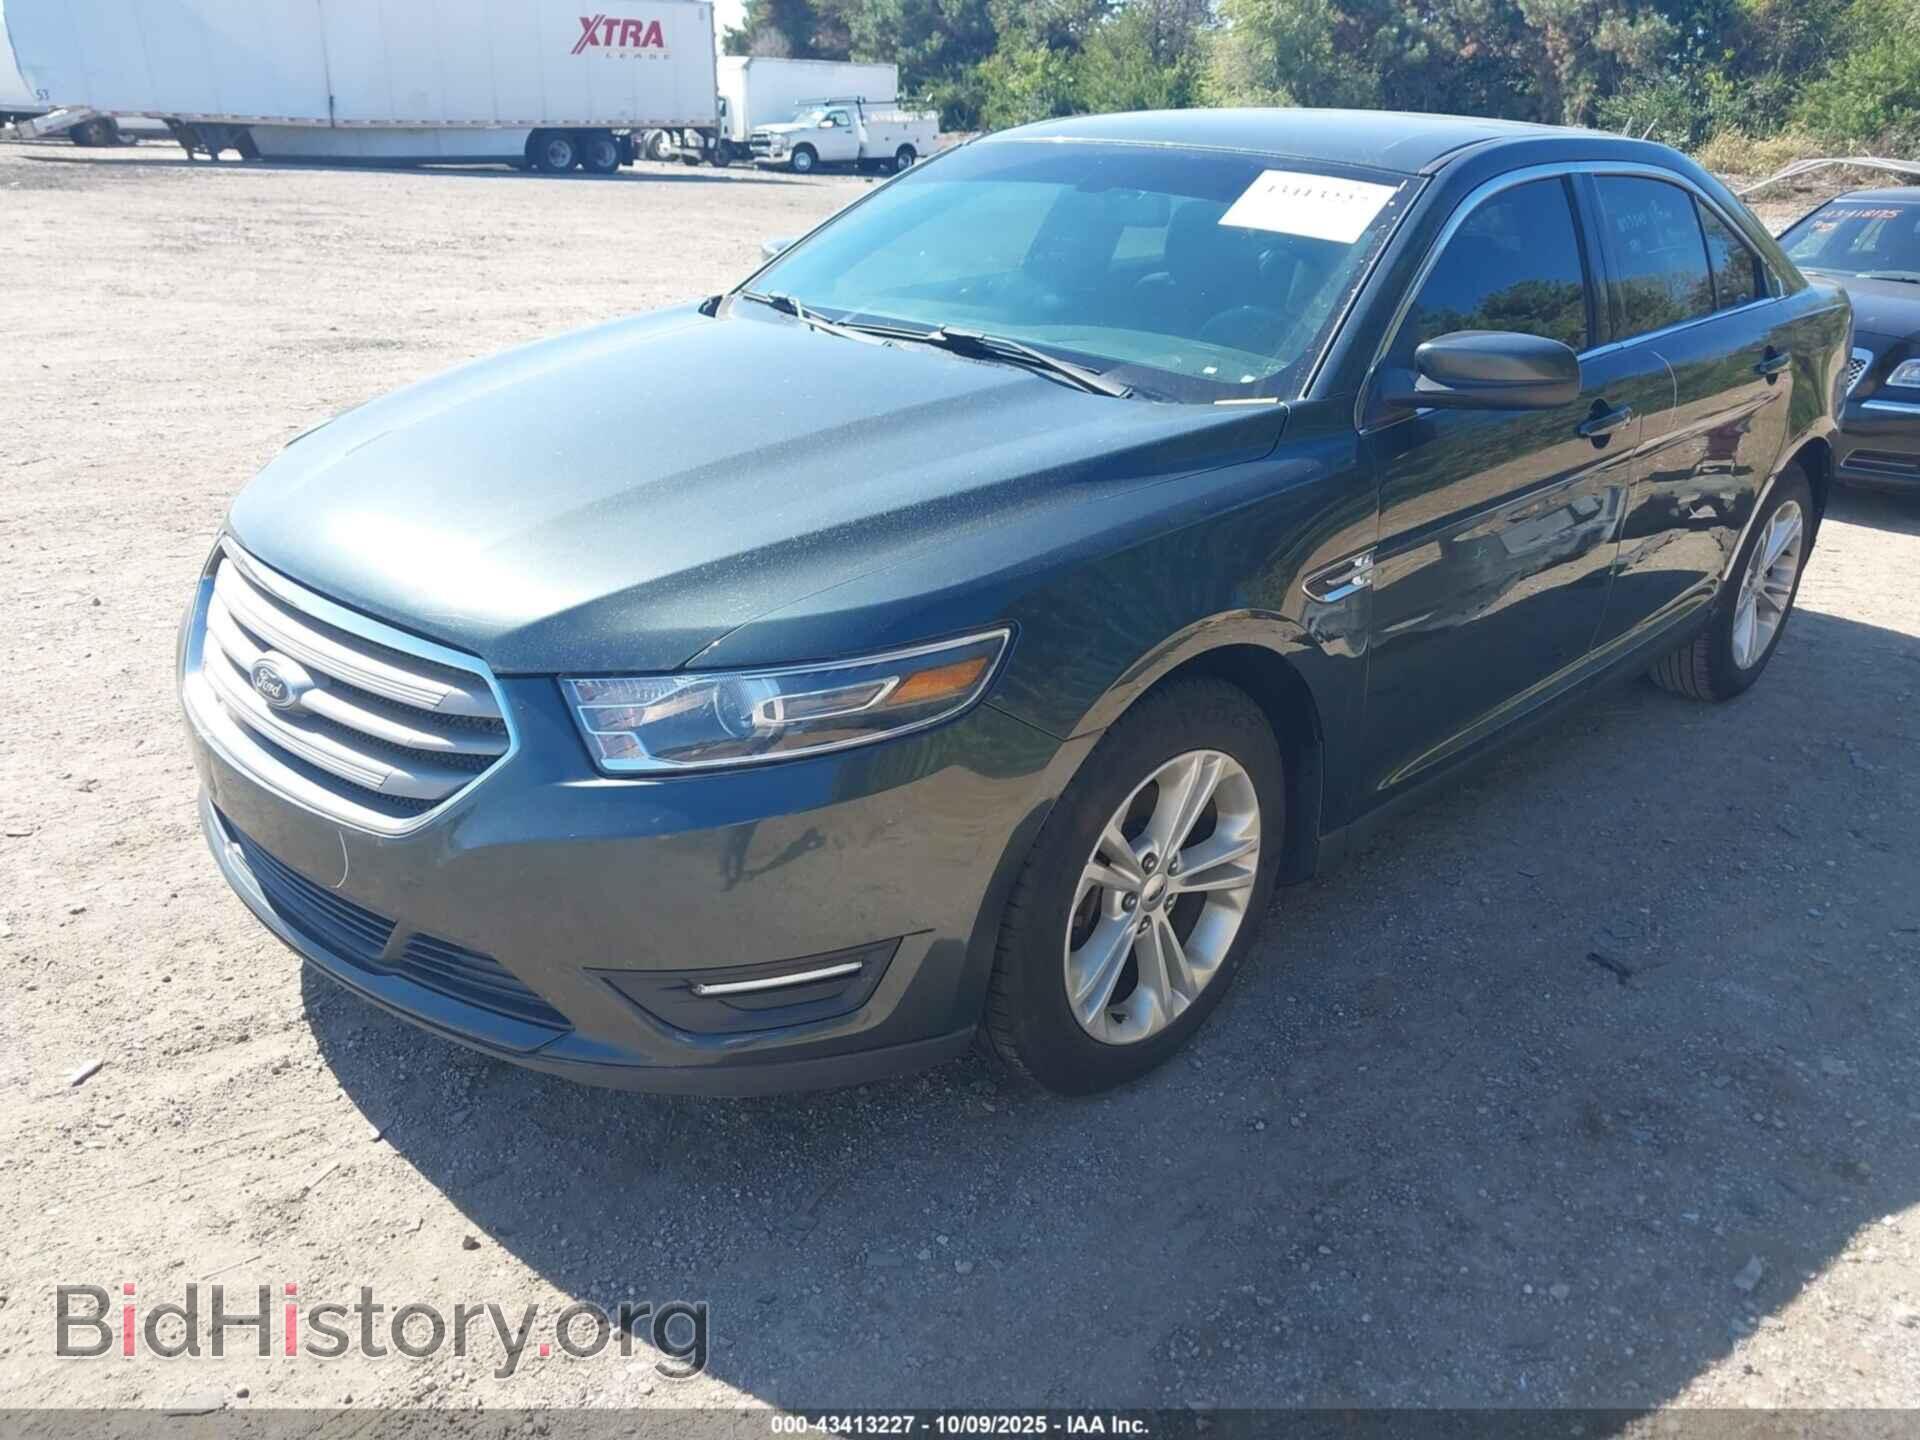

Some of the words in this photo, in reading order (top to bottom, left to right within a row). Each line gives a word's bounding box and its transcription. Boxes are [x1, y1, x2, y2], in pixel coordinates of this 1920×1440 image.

[571, 14, 665, 55] XTRA
[605, 52, 672, 60] LEASE
[256, 667, 283, 698] Ford
